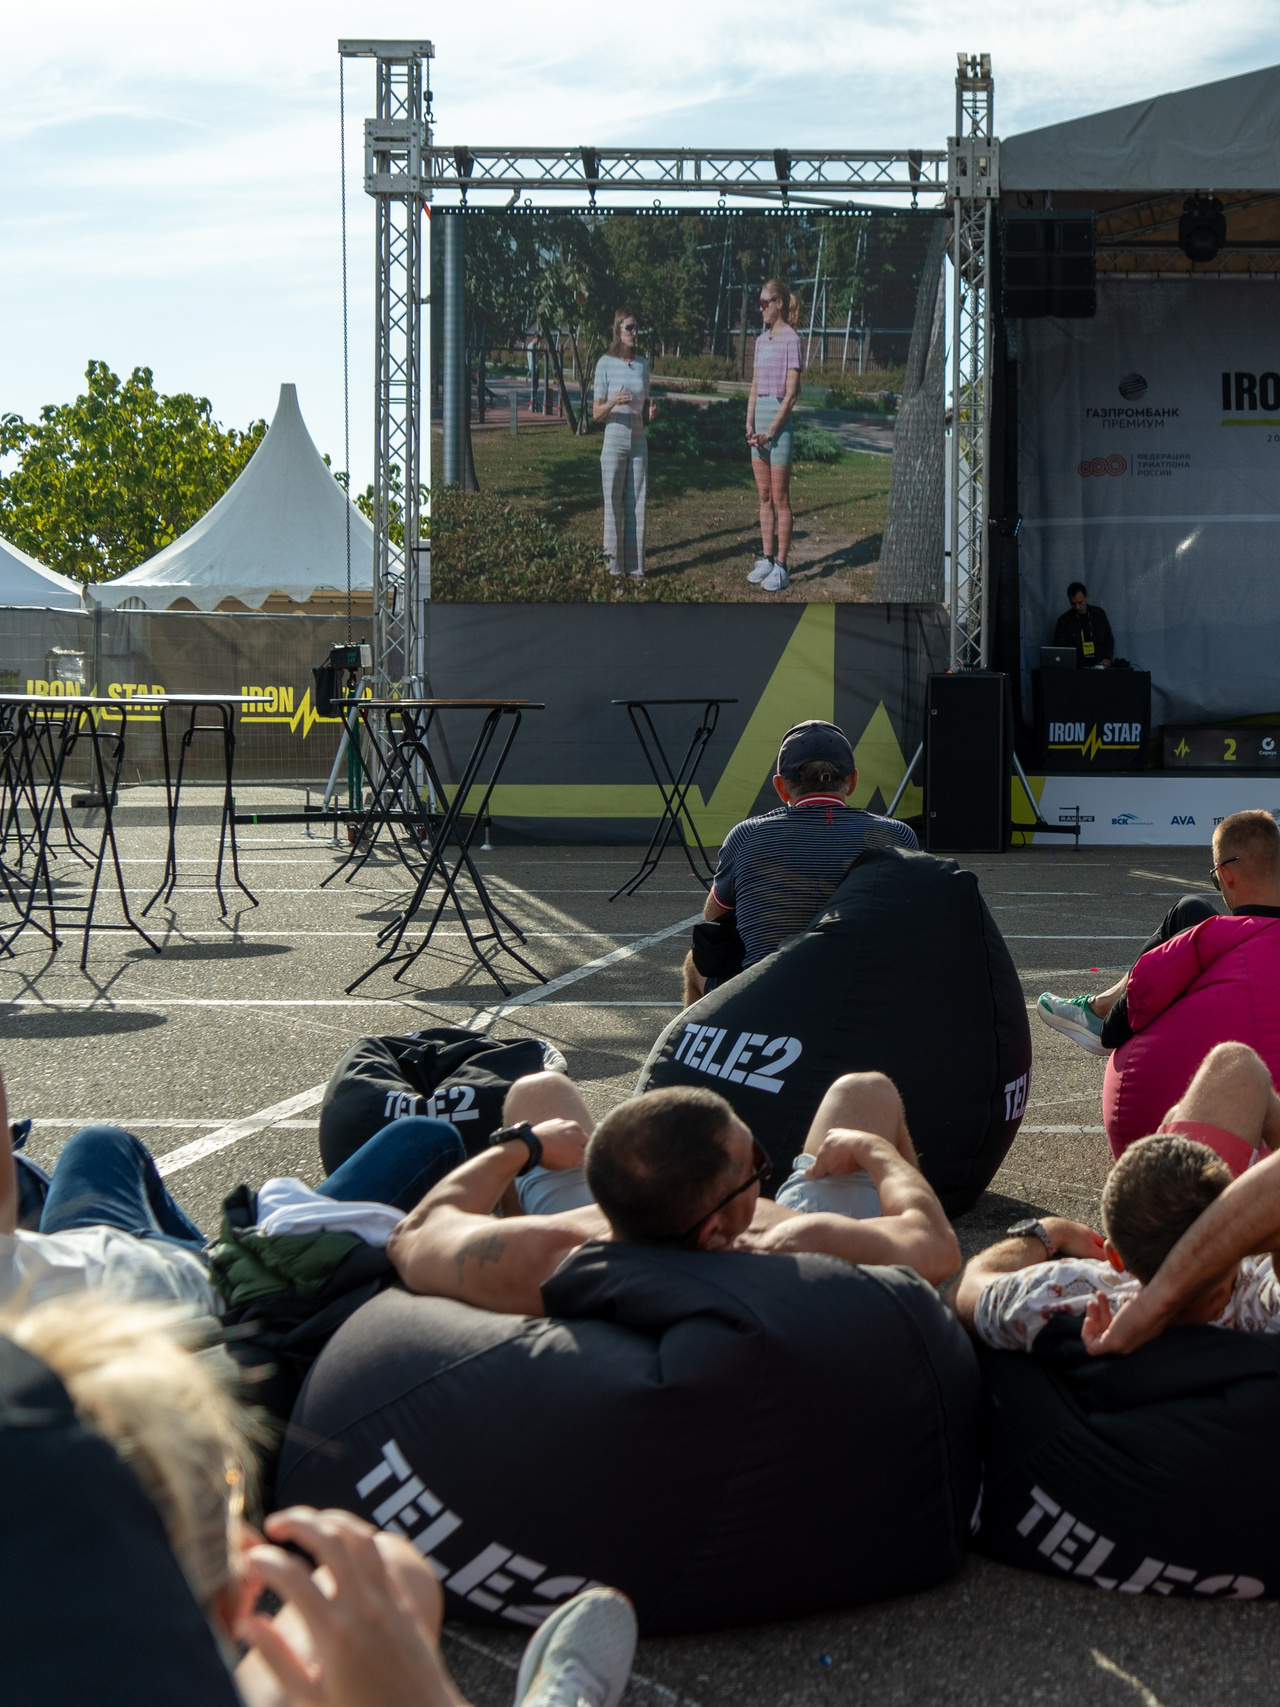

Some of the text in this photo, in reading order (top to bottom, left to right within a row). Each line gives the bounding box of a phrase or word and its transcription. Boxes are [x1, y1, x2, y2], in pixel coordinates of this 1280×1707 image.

[1086, 408, 1179, 418] ГАЗПРОМБАНК
[1102, 419, 1164, 428] ПРЕМИУМ
[241, 686, 293, 713] IRON
[1049, 722, 1141, 742] IRON STAR
[1224, 739, 1236, 760] 2
[1171, 816, 1196, 825] AVA
[674, 1023, 803, 1094] TELE2
[384, 1086, 479, 1122] TELE2
[1004, 1066, 1032, 1121] TEL
